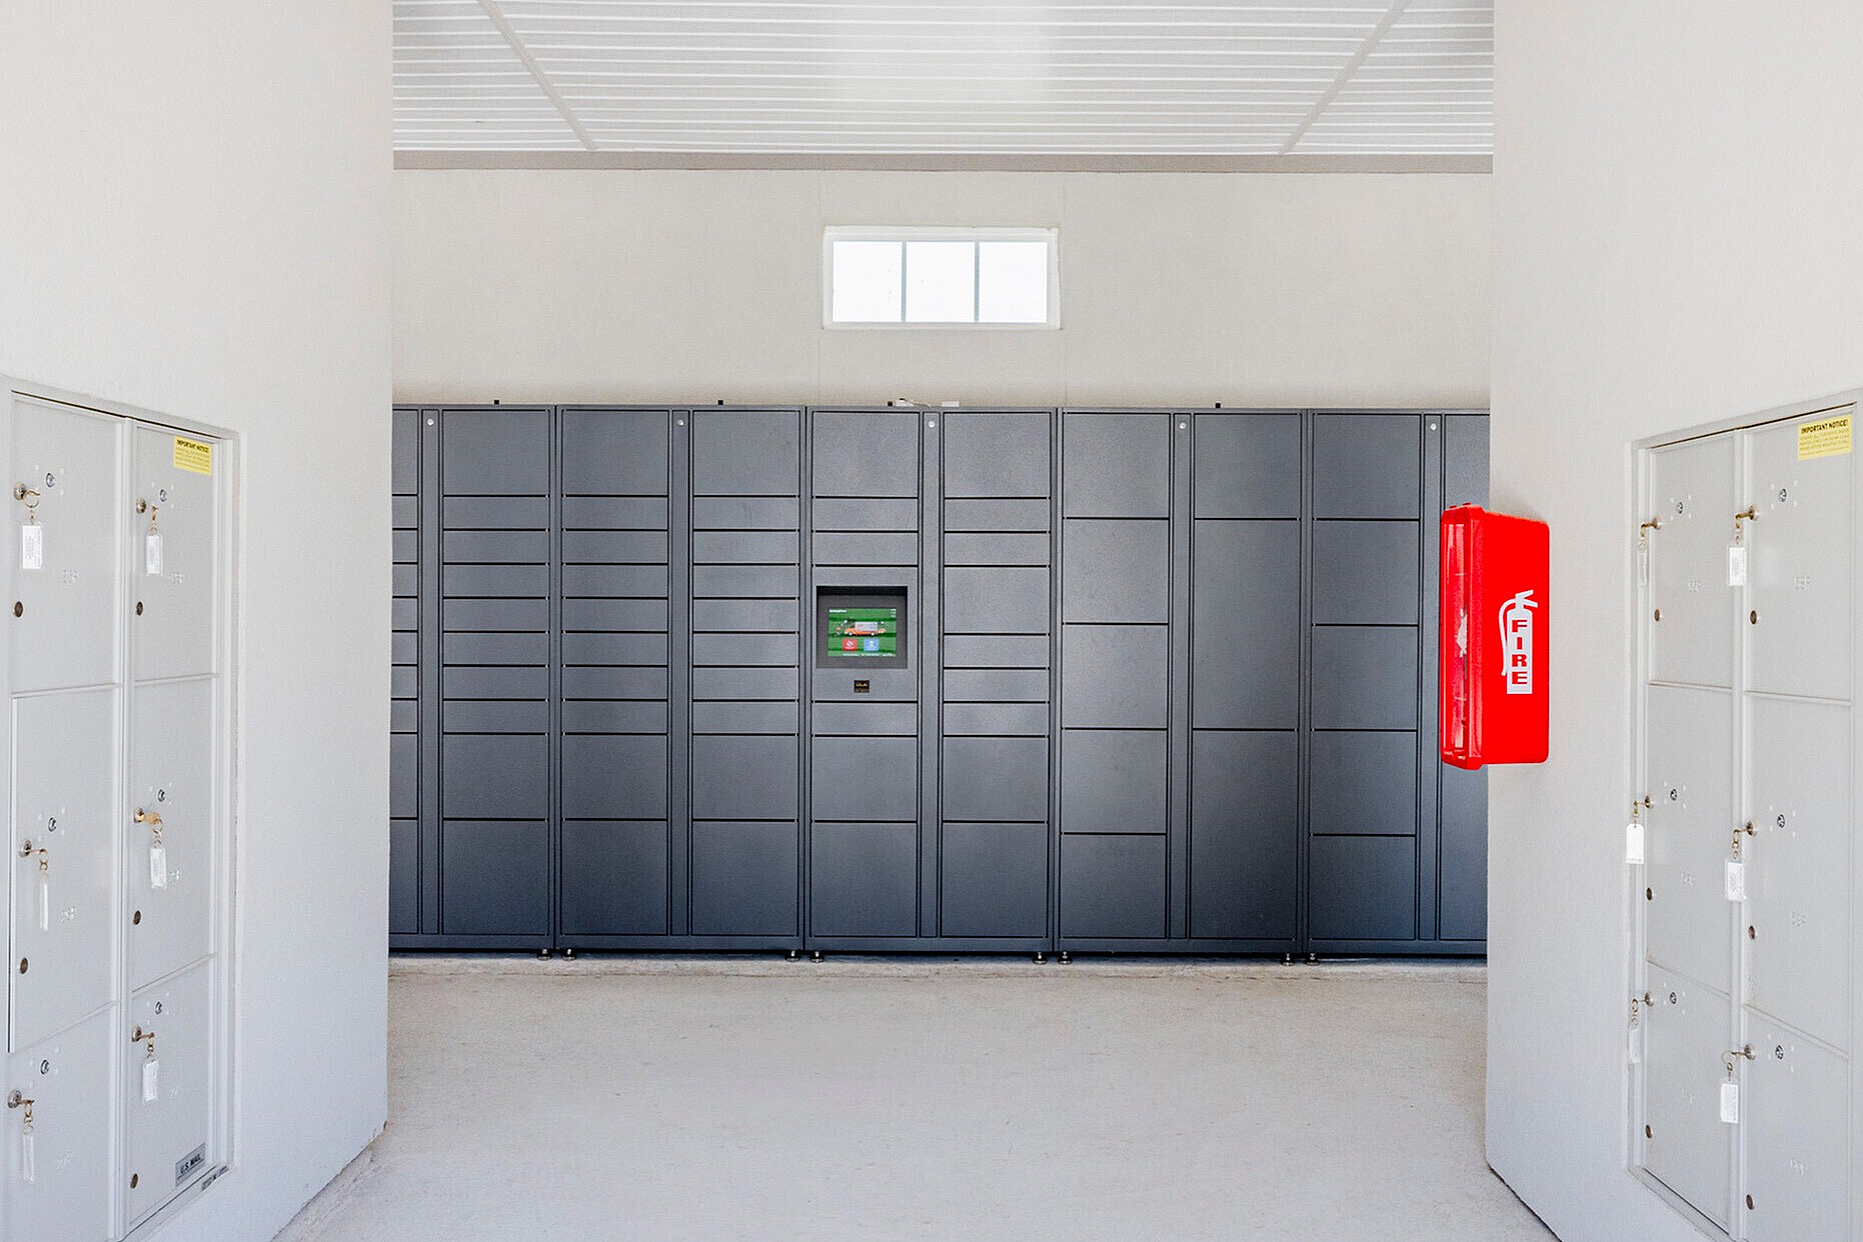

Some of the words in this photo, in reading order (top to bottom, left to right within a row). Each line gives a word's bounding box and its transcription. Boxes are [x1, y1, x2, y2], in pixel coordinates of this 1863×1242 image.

[1801, 423, 1828, 434] IMPORTANT
[176, 439, 197, 449] IMPORTANT
[1511, 619, 1528, 685] FIRE
[190, 1153, 201, 1166] MAIL
